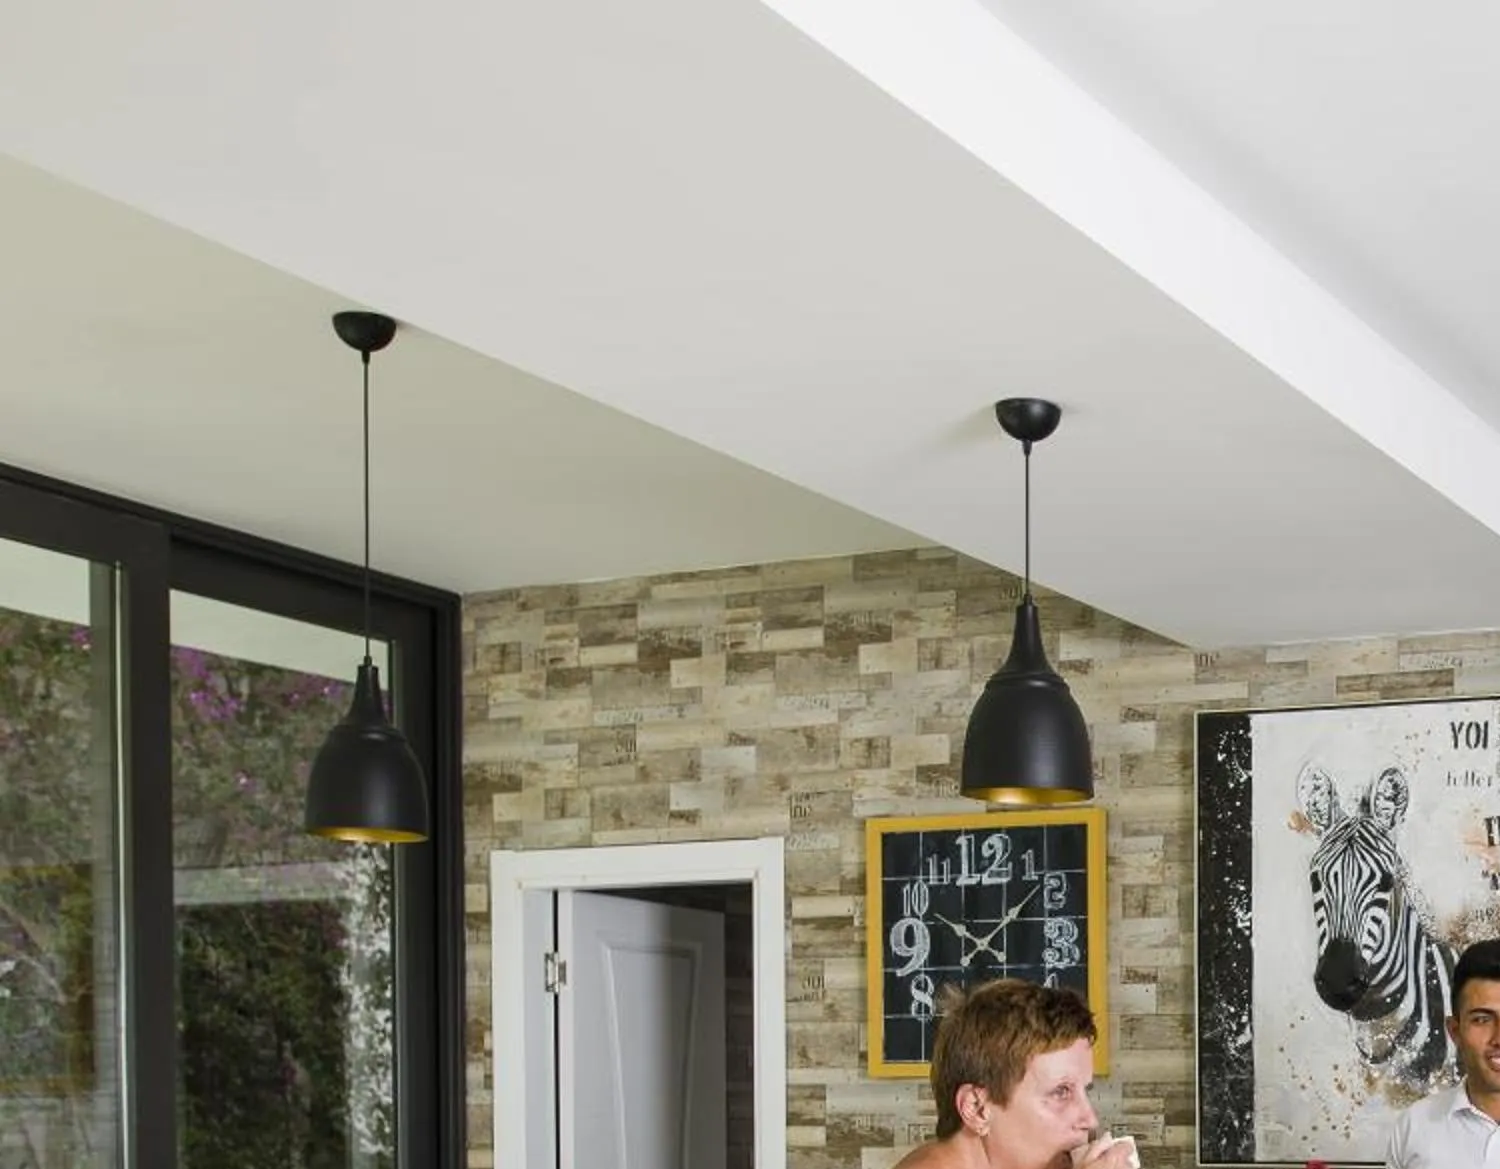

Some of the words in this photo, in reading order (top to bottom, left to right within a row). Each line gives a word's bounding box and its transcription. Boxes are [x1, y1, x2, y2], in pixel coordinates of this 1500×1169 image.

[955, 833, 1013, 886] 12
[903, 879, 929, 917] 10
[889, 916, 931, 977] 9
[1042, 917, 1080, 968] 3
[910, 974, 936, 1021] 8
